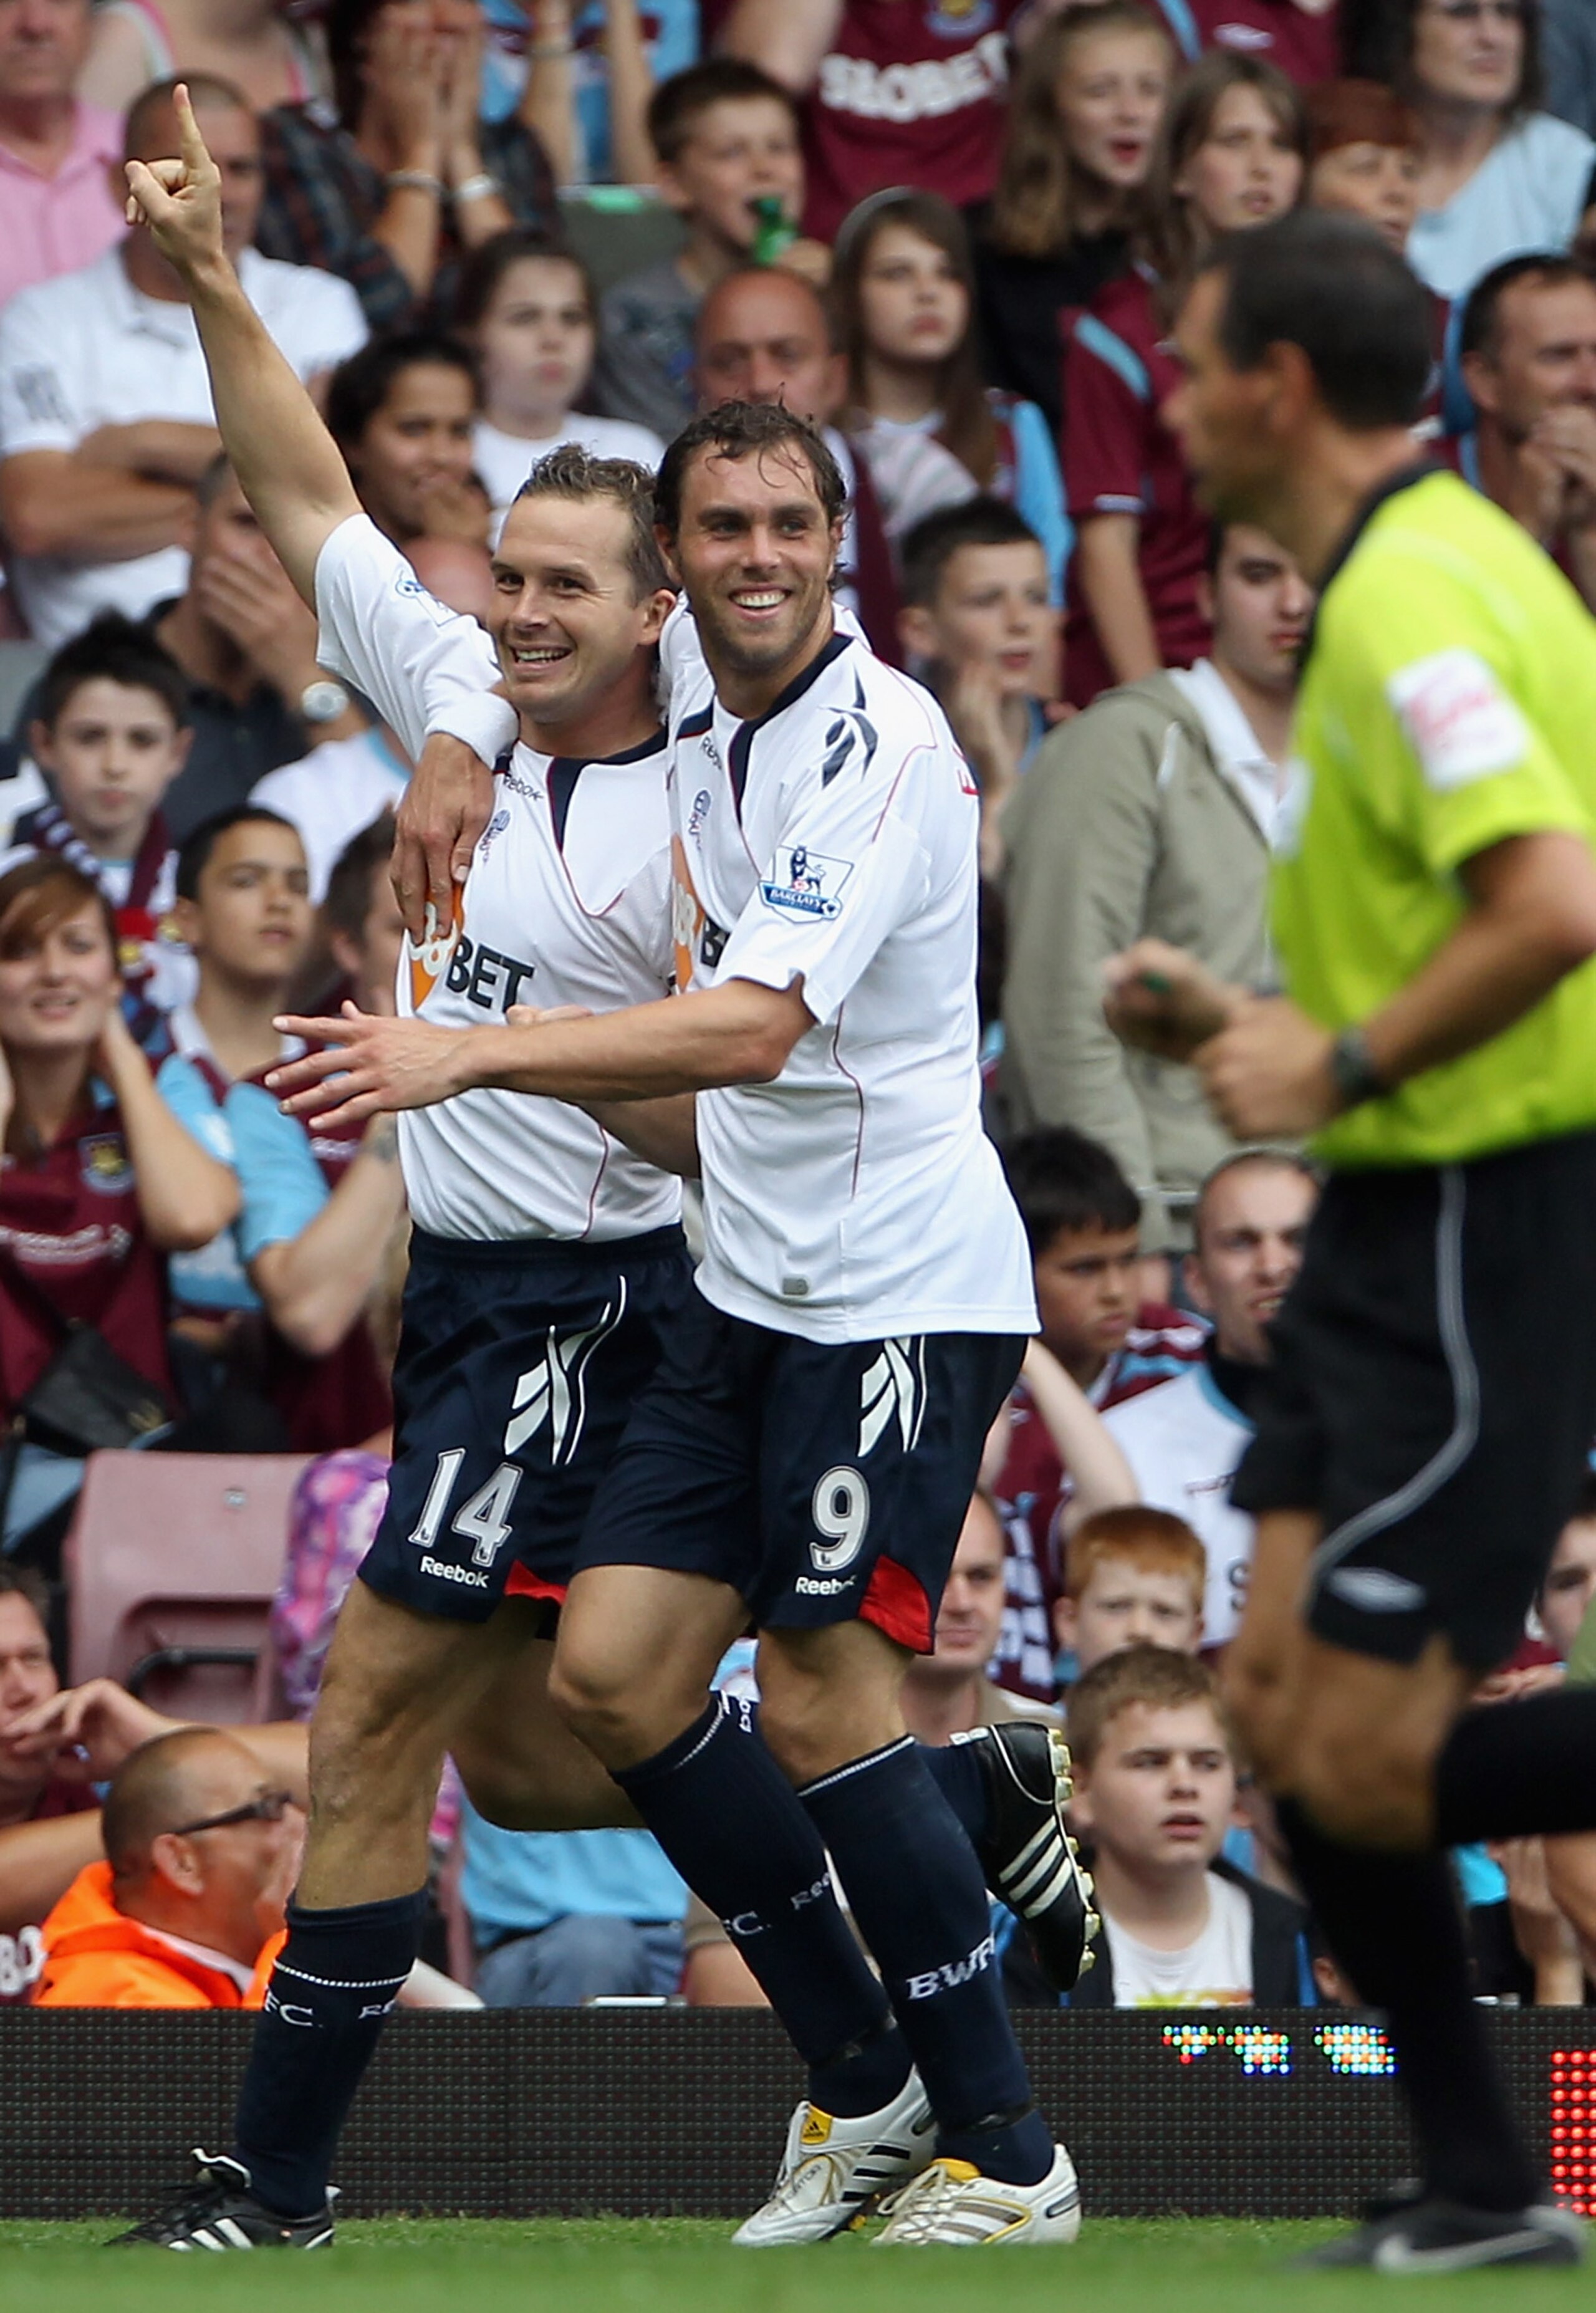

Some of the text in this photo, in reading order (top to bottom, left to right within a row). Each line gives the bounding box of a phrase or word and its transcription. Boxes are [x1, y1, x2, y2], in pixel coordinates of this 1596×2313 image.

[408, 1448, 524, 1567] 14
[809, 1465, 870, 1572] 9
[420, 1556, 489, 1588] Reebok
